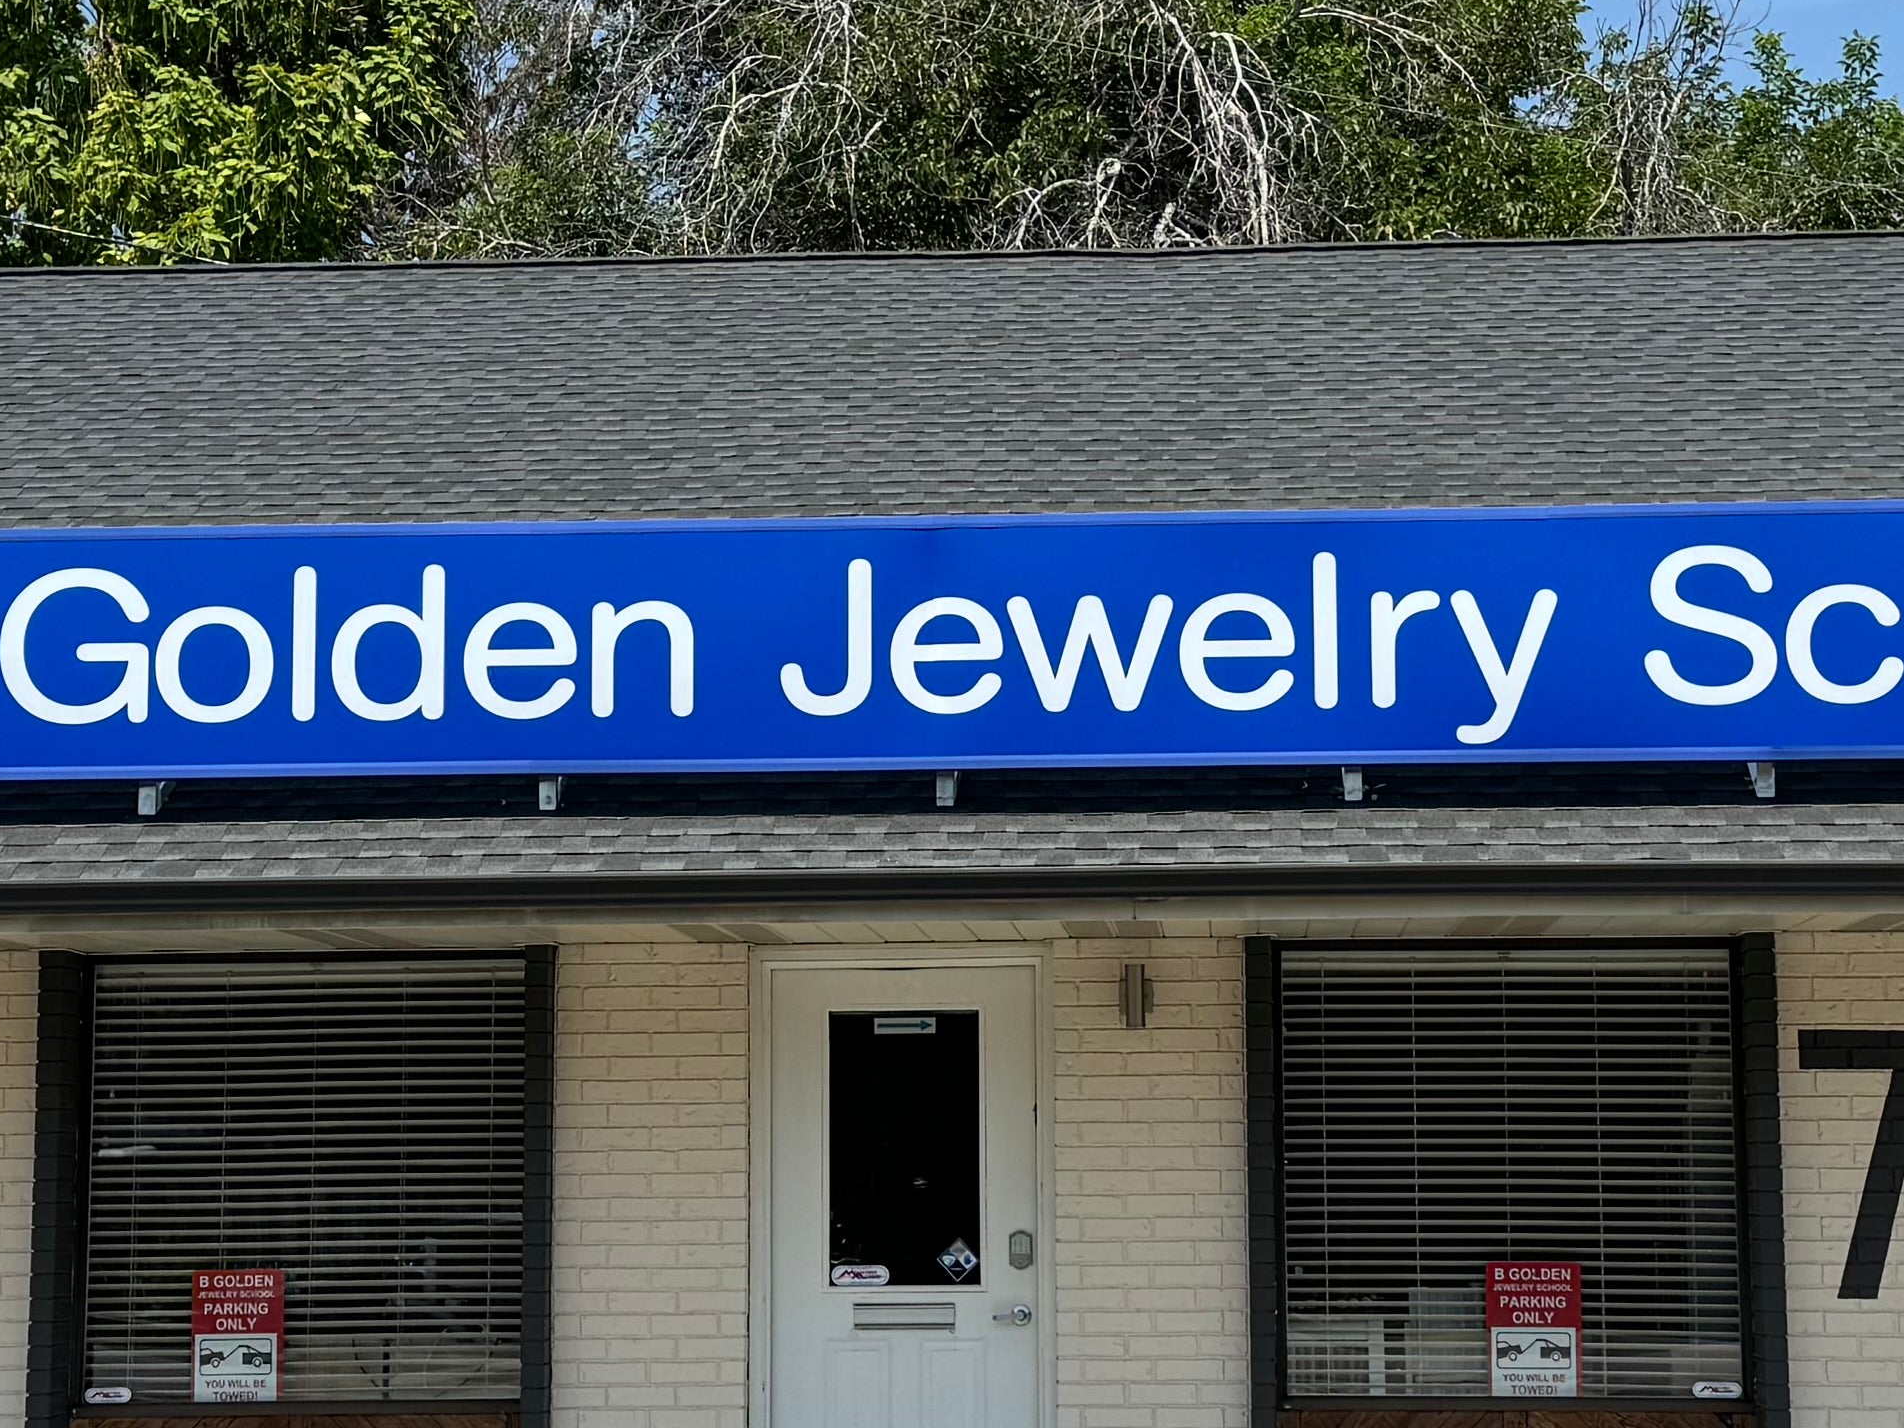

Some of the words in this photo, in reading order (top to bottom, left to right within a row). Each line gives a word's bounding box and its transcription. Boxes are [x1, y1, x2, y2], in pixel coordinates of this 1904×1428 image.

[0, 565, 693, 724] Golden
[781, 552, 1557, 743] Jewelry
[1494, 1268, 1505, 1280] B
[1509, 1268, 1571, 1280] GOLDEN
[199, 1275, 209, 1288] B
[214, 1275, 274, 1287] GOLDEN
[1500, 1296, 1566, 1308] PARKING
[204, 1303, 269, 1315] PARKING
[1512, 1311, 1554, 1324] ONLY
[216, 1317, 257, 1331] ONLY
[205, 1380, 225, 1389] YOU
[228, 1380, 251, 1389] WILL
[253, 1379, 266, 1388] BE
[1502, 1374, 1524, 1382] YOU
[1526, 1374, 1549, 1382] WILL
[1552, 1374, 1566, 1382] BE
[1511, 1385, 1558, 1395] TOWED!
[213, 1391, 258, 1402] TOWED!
